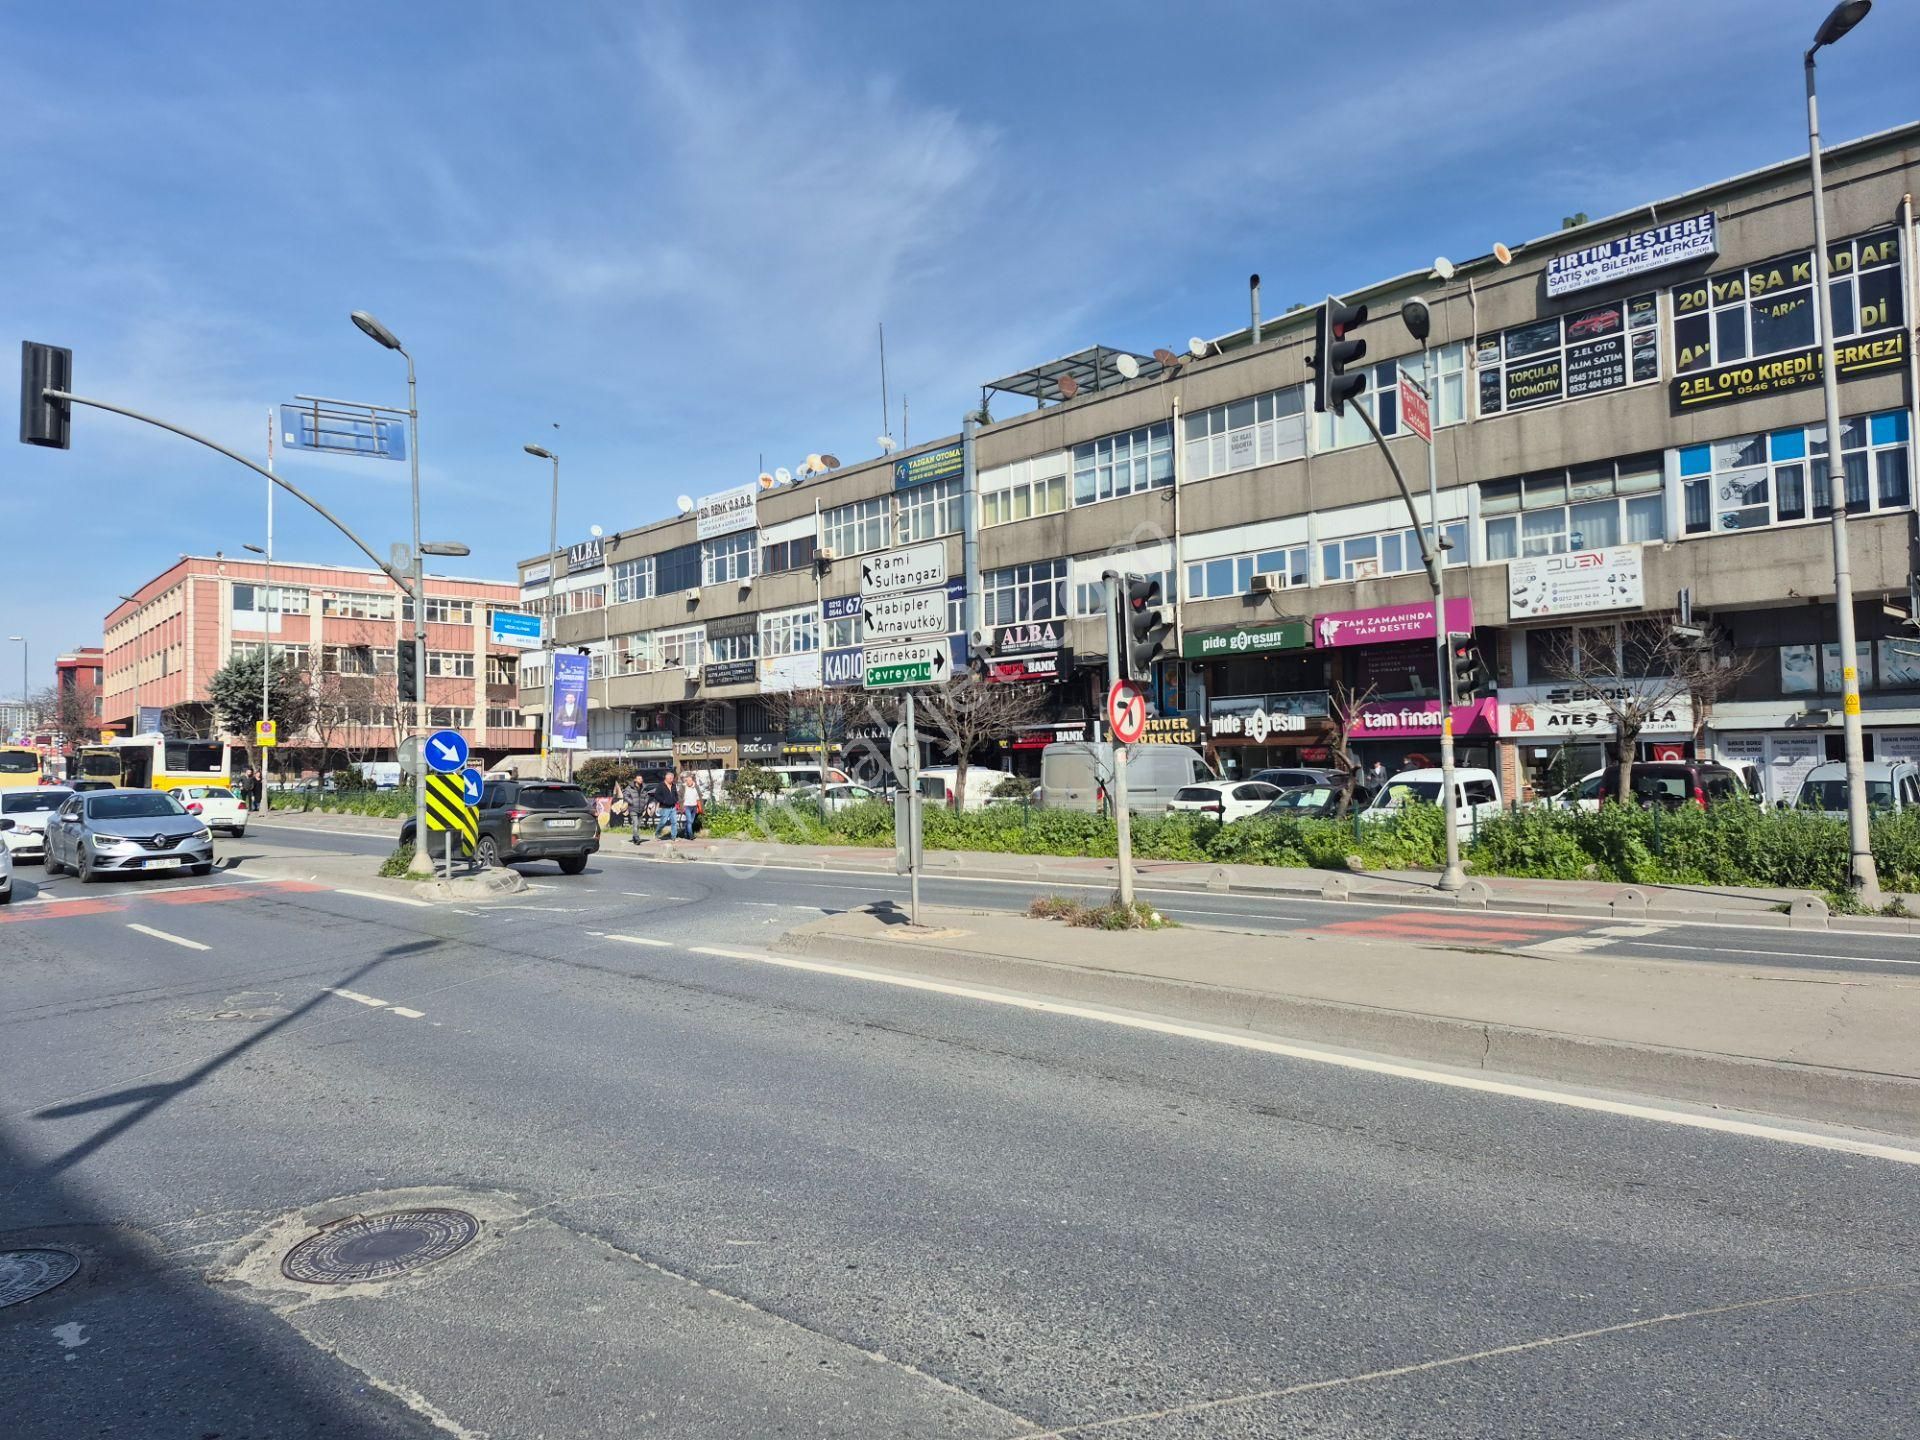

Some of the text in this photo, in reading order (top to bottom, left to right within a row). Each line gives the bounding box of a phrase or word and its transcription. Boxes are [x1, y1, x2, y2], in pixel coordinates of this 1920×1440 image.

[1548, 214, 1711, 274] FIRTIN TESTERE
[1550, 269, 1582, 287] SATIŞ
[1585, 267, 1598, 276] ve
[1679, 289, 1707, 311] 20
[1713, 269, 1784, 302] YAŞA
[1573, 341, 1616, 358] 2.EL OTO
[1569, 352, 1623, 371] ALIM SATIM
[1680, 334, 1903, 397] 2.EL OTO KREDİ ERKEZİ
[1510, 364, 1559, 384] TOPÇULAR
[1569, 364, 1623, 384] 0545 712 73 56
[1509, 378, 1559, 399] OTOMOTİV
[1569, 384, 1587, 394] 0532
[1588, 380, 1601, 390] 404
[1603, 378, 1612, 387] 99
[1737, 382, 1768, 395] 0546
[1774, 377, 1796, 388] 166
[1800, 373, 1816, 383] 70
[570, 540, 600, 563] ALBA
[874, 553, 909, 570] Rami
[876, 565, 941, 588] Sultangazi
[876, 598, 929, 615] Habipler
[877, 614, 943, 633] Arnavutköy
[1368, 611, 1433, 625] ZAMANINDA
[1001, 623, 1056, 645] ALBA
[1355, 622, 1421, 635] TAM DESTEK
[1203, 636, 1227, 652] pide
[866, 648, 930, 664] Edirnekapı
[867, 664, 931, 683] Çevreyolu
[1028, 661, 1056, 673] BANK
[1212, 715, 1240, 737] pide
[1363, 709, 1453, 728] tam finan
[1548, 713, 1597, 727] ATEŞ
[1056, 731, 1083, 742] BANK
[675, 741, 716, 755] TOKSAN
